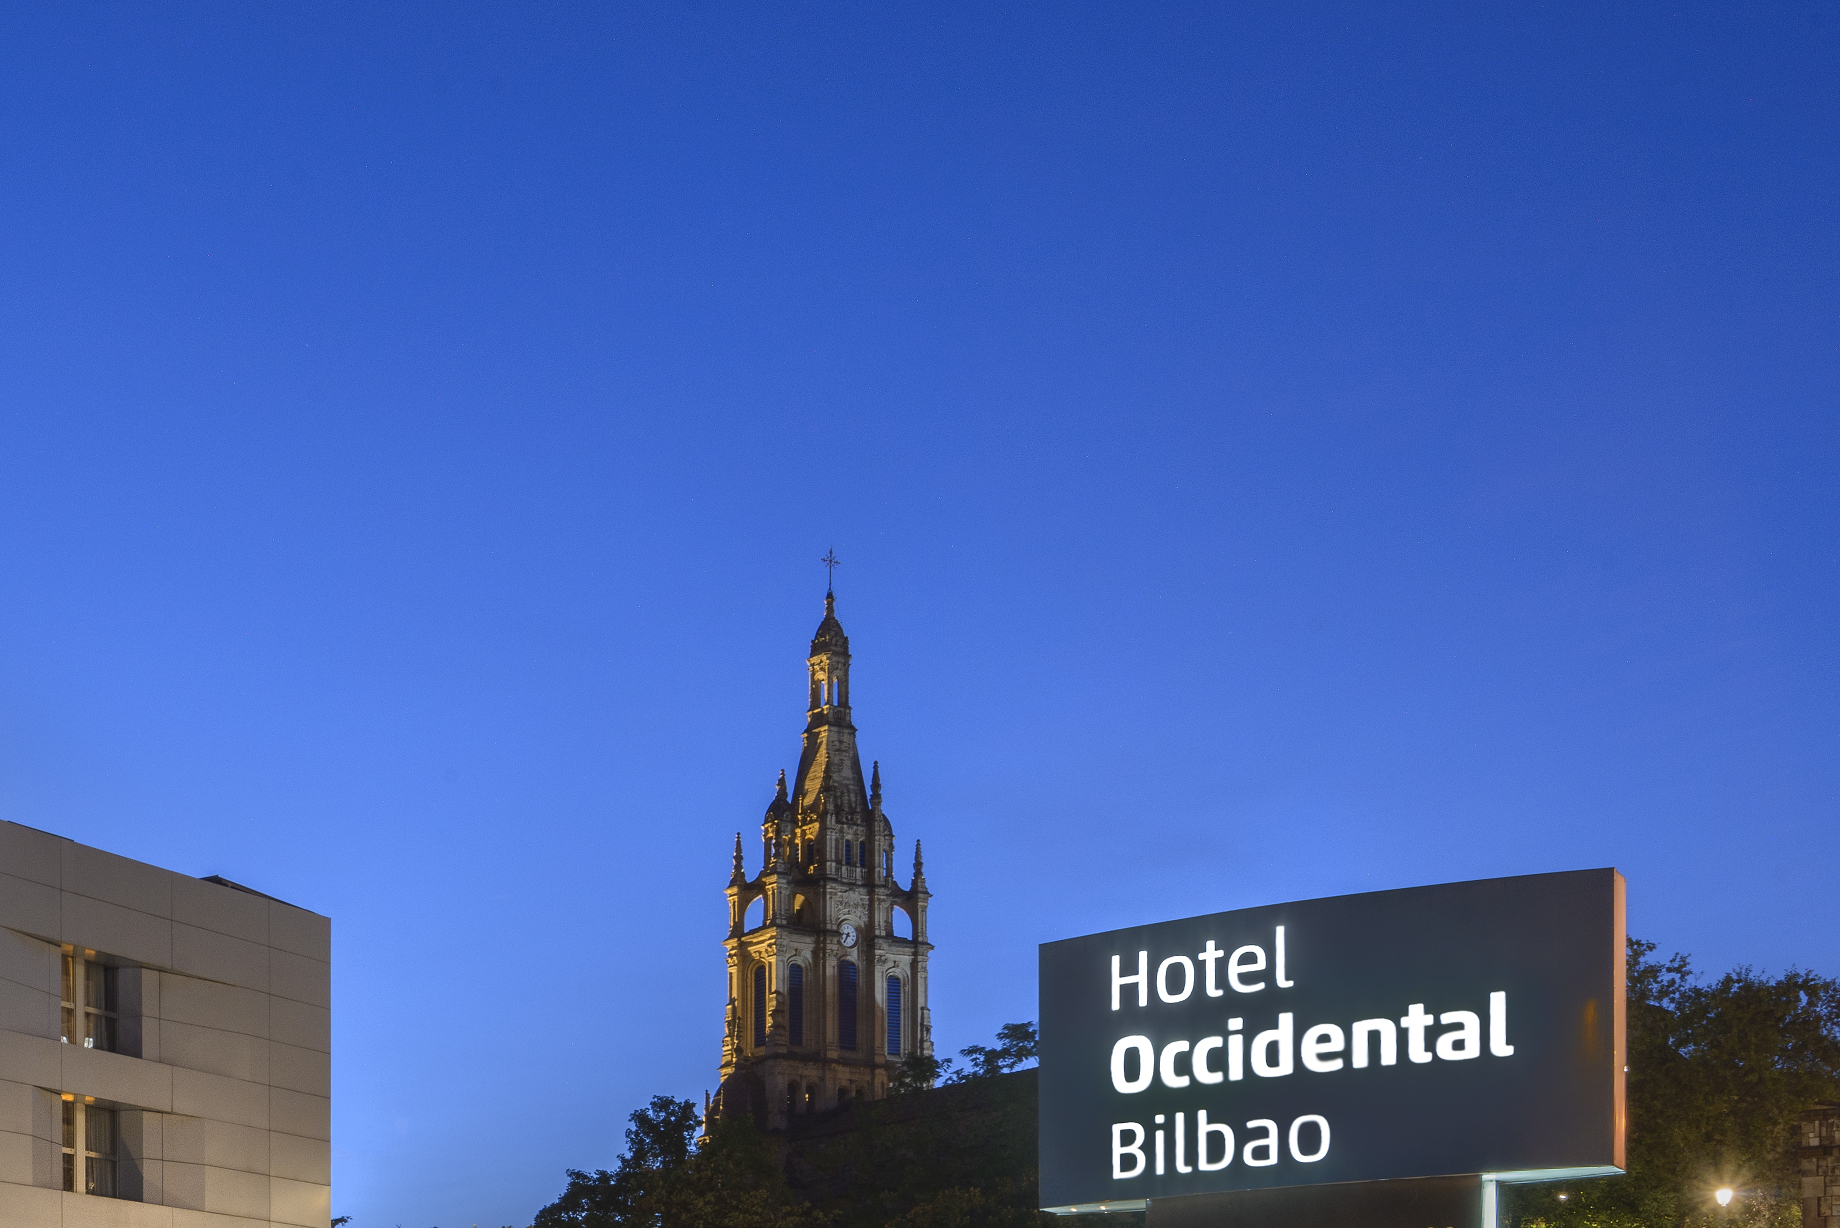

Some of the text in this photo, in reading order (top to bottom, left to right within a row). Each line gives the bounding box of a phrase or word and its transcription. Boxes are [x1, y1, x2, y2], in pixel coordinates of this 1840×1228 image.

[1111, 925, 1295, 1011] Hotel
[1110, 990, 1515, 1094] Occidental
[1111, 1109, 1331, 1180] Bilbao
